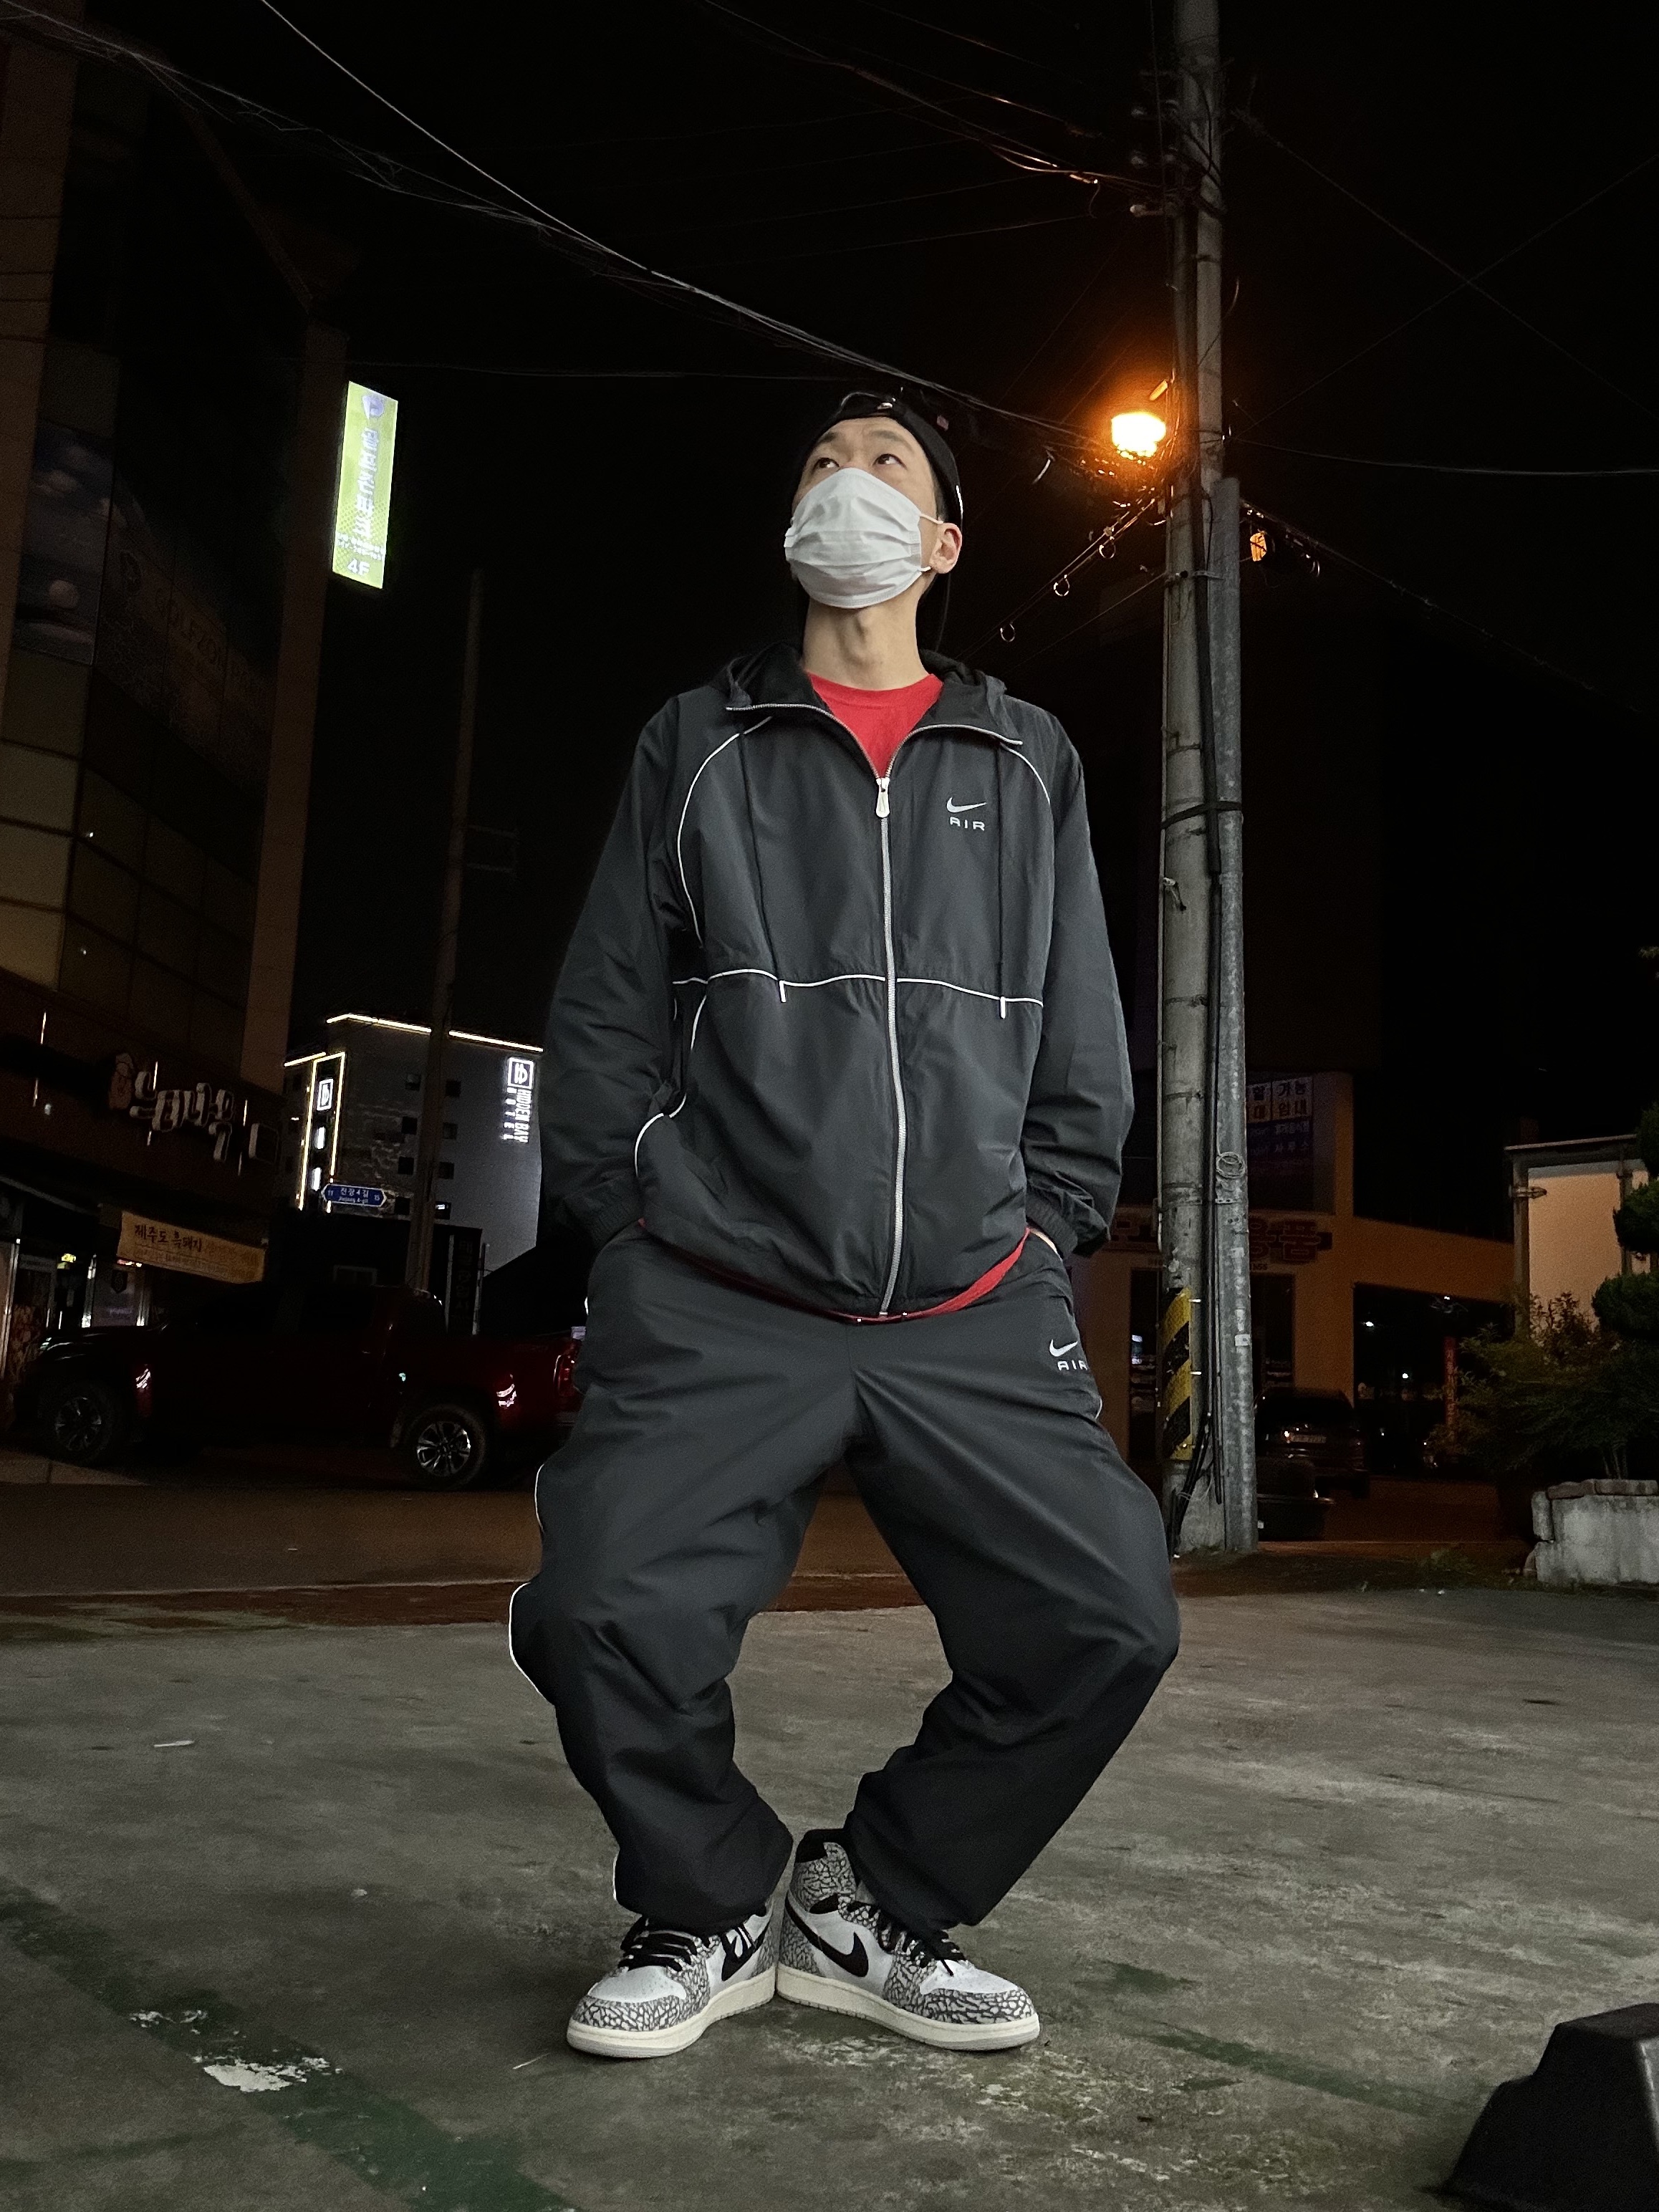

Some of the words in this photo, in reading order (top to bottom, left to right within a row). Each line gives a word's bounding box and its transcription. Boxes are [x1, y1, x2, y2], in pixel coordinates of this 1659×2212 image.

[347, 558, 370, 576] 4F
[950, 817, 985, 831] AIR
[516, 1088, 532, 1122] HIDDEN
[514, 1122, 529, 1143] BAY
[134, 1223, 168, 1244] 제주도
[170, 1230, 203, 1252] 흑돼지
[1057, 1360, 1087, 1371] AIR
